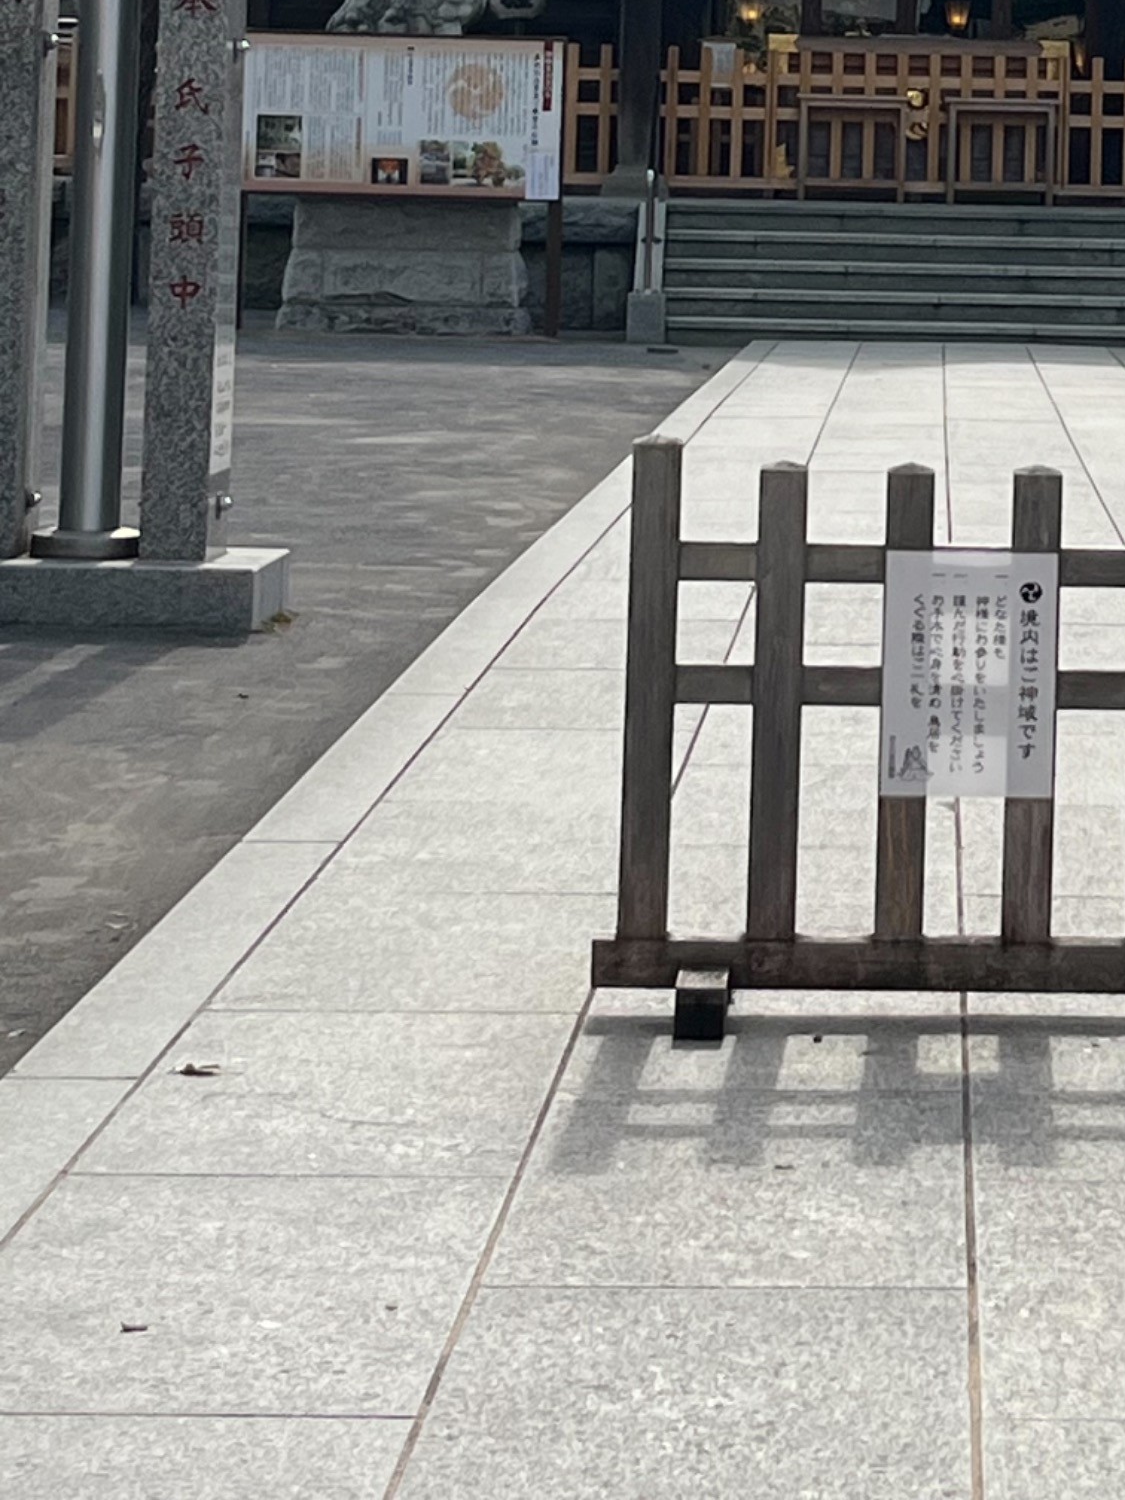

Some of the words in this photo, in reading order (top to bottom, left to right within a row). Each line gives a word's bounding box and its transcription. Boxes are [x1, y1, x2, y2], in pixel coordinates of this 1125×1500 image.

[168, 78, 210, 310] 氏子頭中
[972, 595, 990, 774] 神様にお参りをいたしましょう
[1016, 608, 1041, 760] 境内はご神域です
